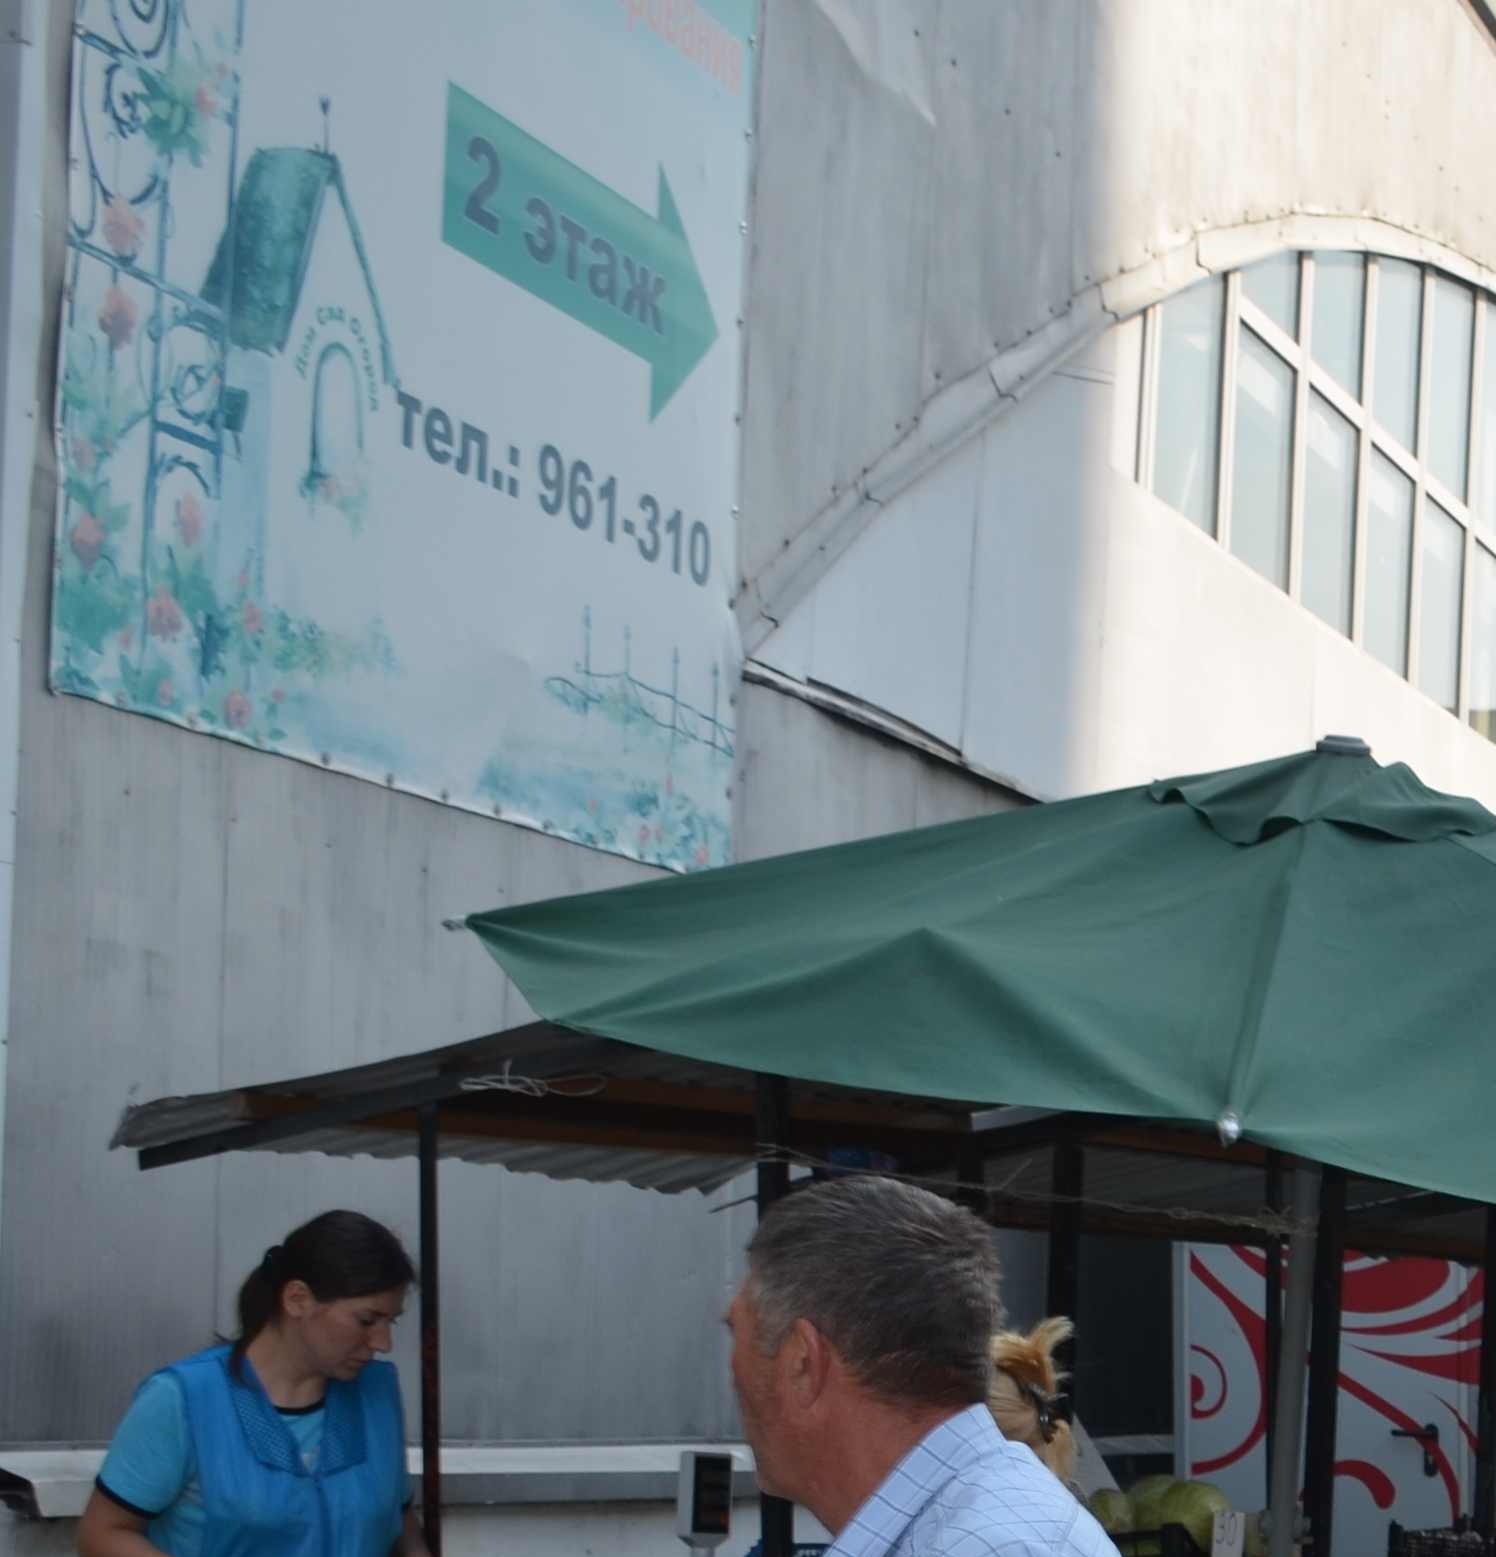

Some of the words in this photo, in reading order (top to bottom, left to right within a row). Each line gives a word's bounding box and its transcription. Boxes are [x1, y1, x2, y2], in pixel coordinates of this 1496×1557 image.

[463, 135, 501, 236] 2
[522, 196, 667, 336] этаж
[397, 390, 521, 499] тел.:
[538, 443, 712, 588] 961-310
